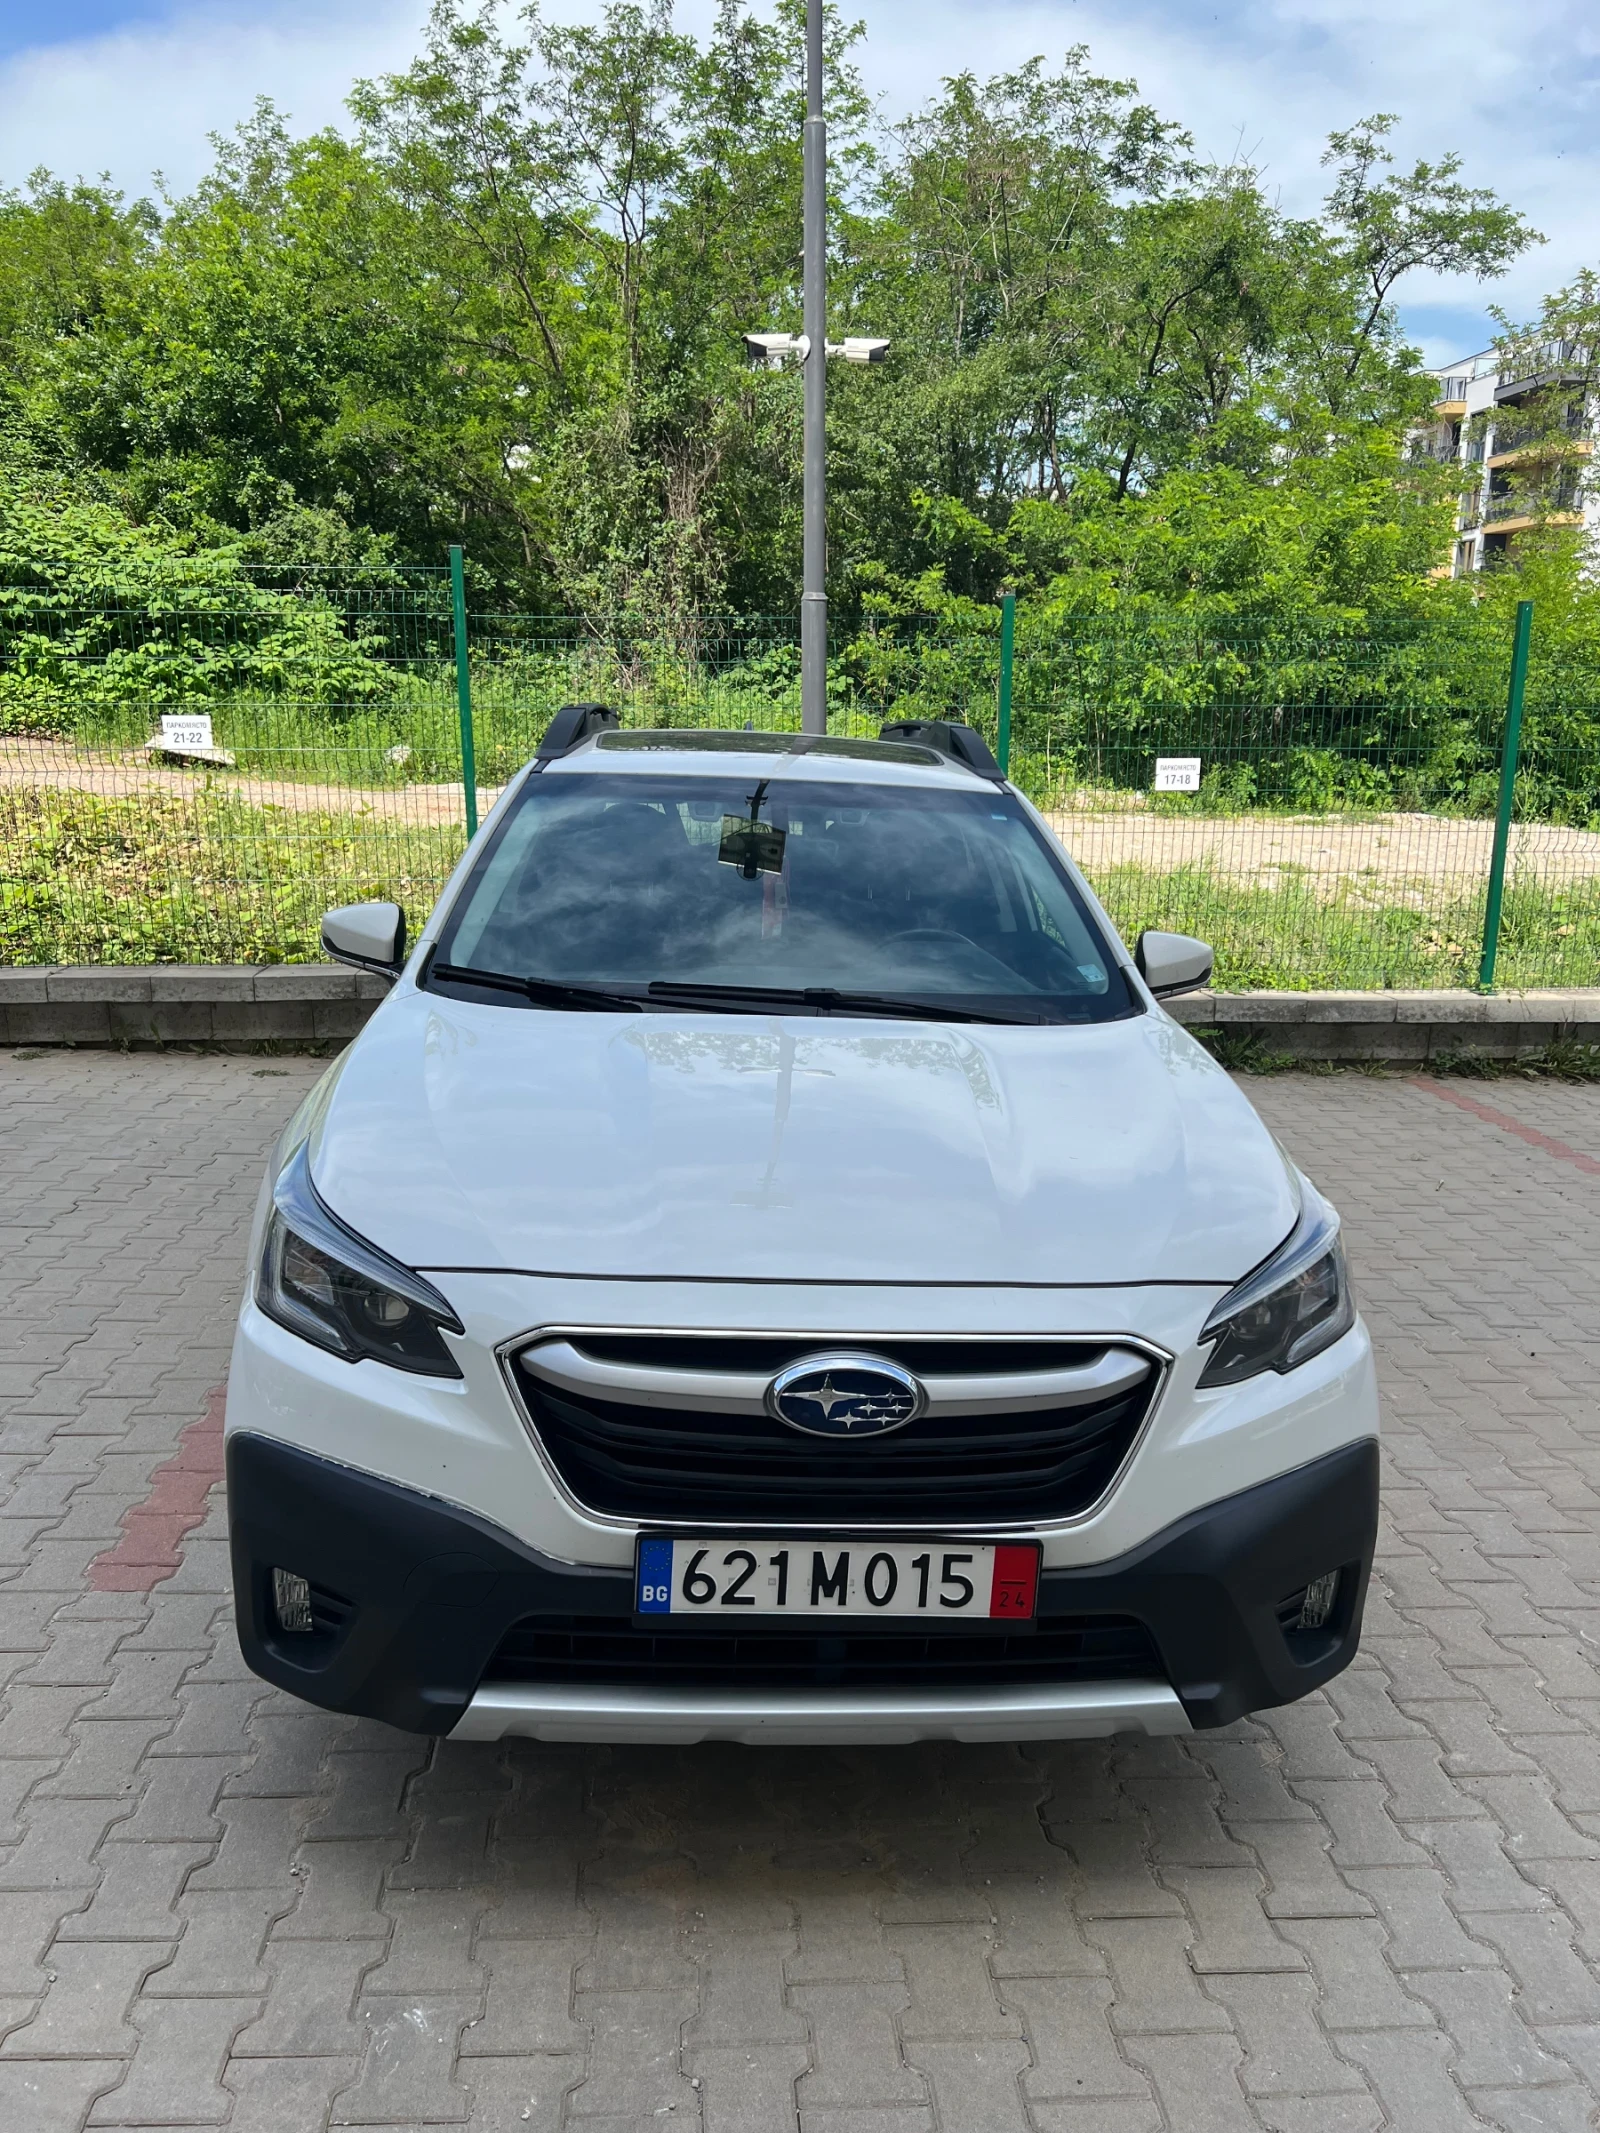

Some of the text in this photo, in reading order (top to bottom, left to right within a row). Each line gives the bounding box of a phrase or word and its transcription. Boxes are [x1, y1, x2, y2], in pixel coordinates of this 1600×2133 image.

[166, 721, 207, 729] ПАРКОМЯСТО
[173, 732, 203, 743] 21-22
[1165, 774, 1191, 785] 17-18
[642, 1585, 668, 1602] BG
[998, 1590, 1026, 1608] 24
